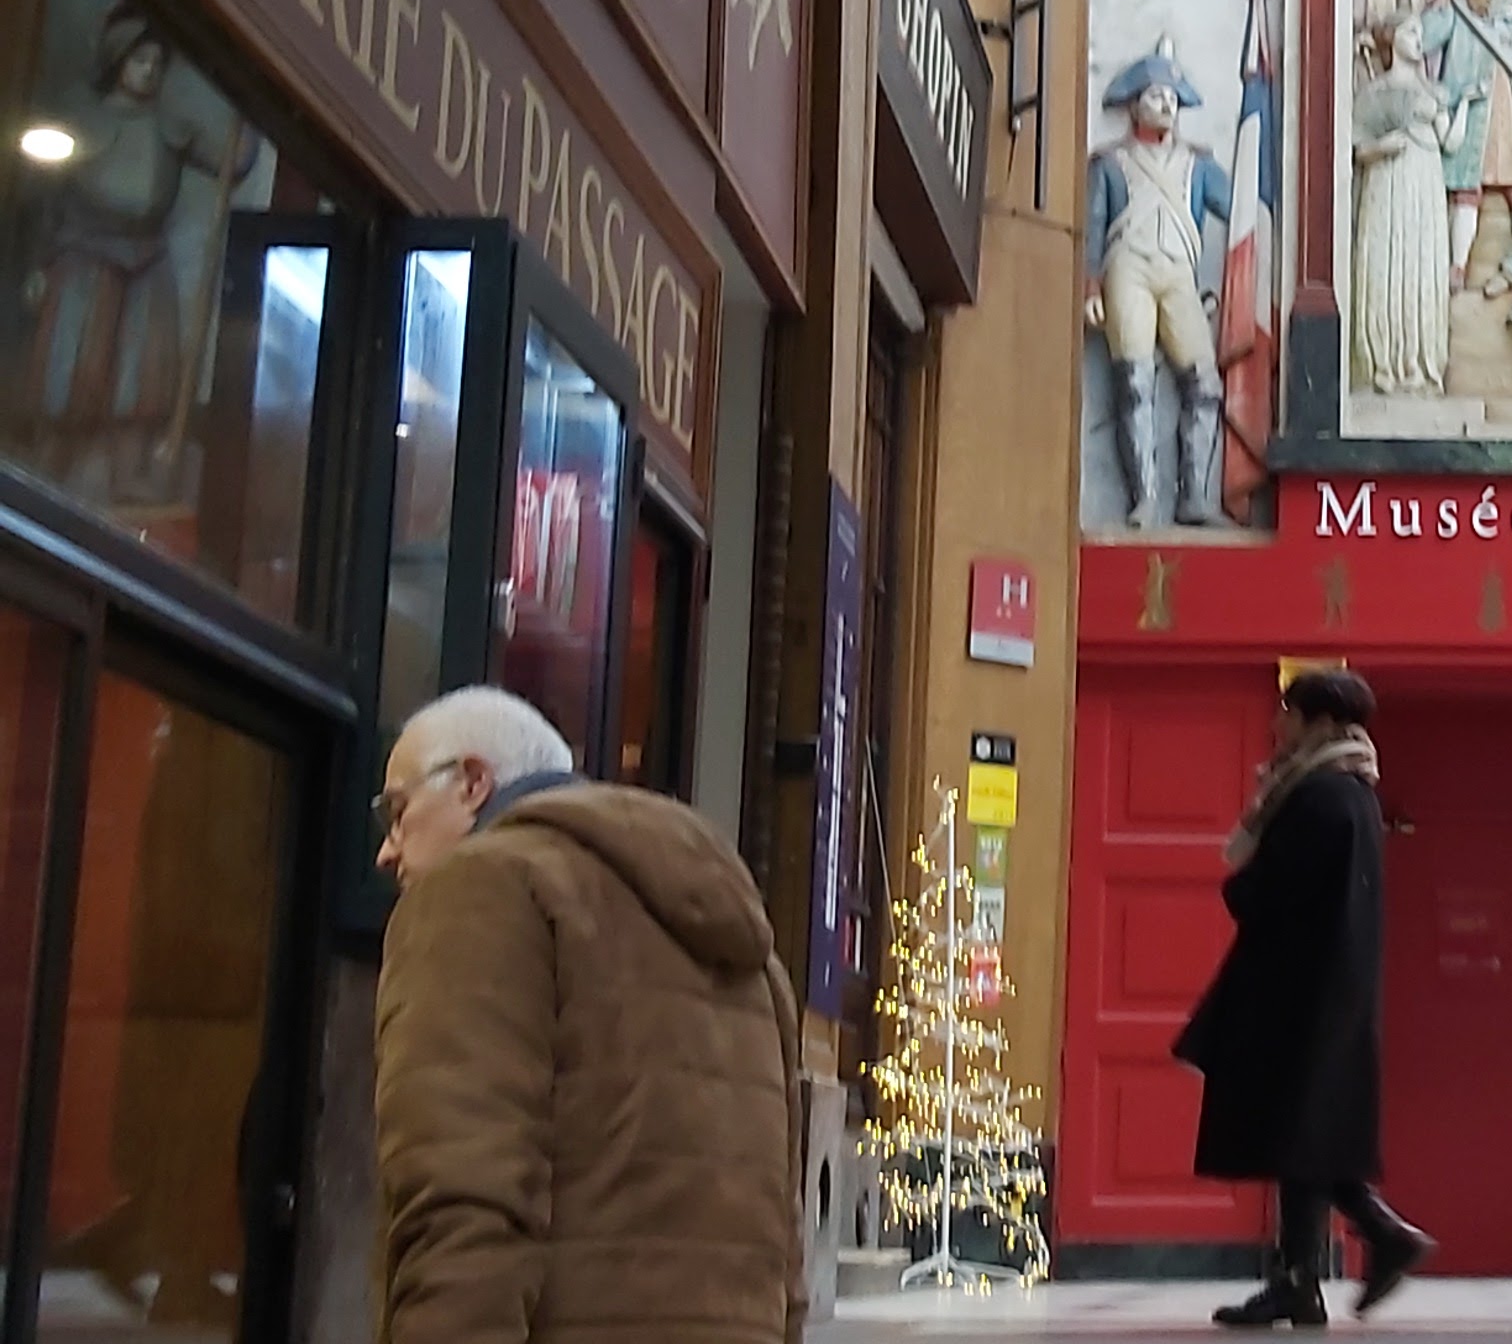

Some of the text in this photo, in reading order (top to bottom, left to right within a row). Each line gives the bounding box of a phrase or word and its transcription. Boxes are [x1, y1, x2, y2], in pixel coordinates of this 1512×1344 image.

[436, 9, 512, 218] DU
[517, 74, 699, 453] PASSAGE
[1002, 573, 1028, 609] H
